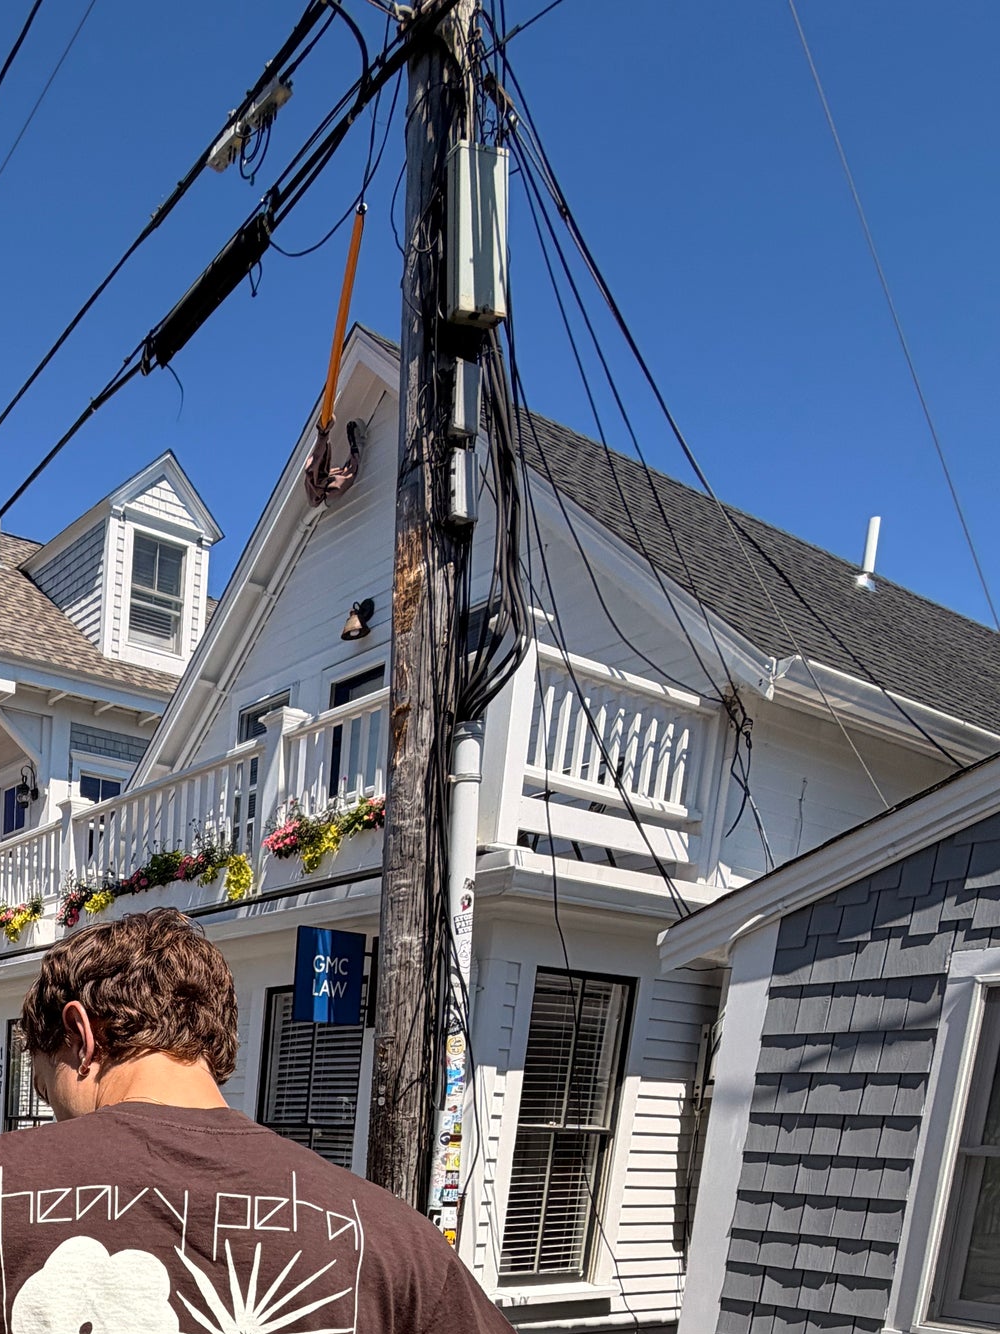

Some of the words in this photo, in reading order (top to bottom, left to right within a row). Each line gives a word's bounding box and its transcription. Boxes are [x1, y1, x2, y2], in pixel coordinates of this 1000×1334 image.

[313, 954, 349, 975] GMC
[312, 978, 347, 998] LAW
[212, 1170, 364, 1262] petal
